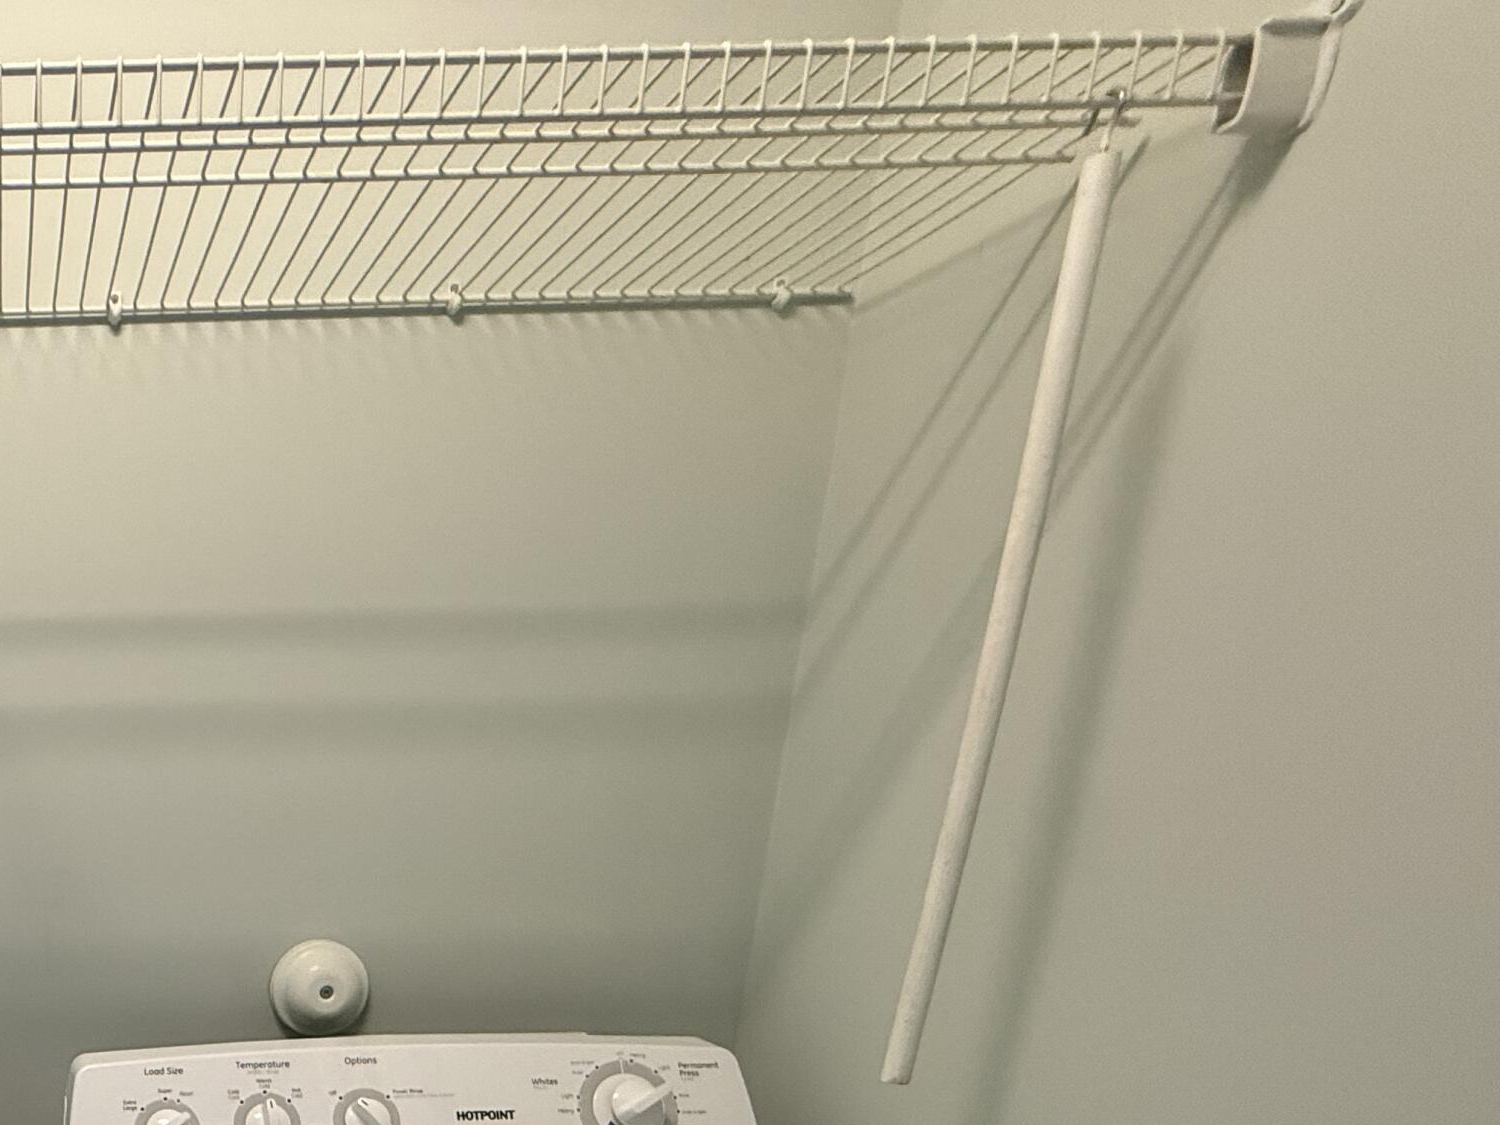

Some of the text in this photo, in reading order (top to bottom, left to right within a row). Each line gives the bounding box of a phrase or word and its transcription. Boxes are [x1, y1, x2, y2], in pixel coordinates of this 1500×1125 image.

[235, 1060, 291, 1070] Temperature
[344, 1056, 378, 1066] Options
[677, 1061, 719, 1070] Permanent
[143, 1066, 184, 1076] Load Size
[679, 1069, 700, 1077] Press
[531, 1077, 558, 1086] Whites
[456, 1109, 516, 1122] HOTPOINT
